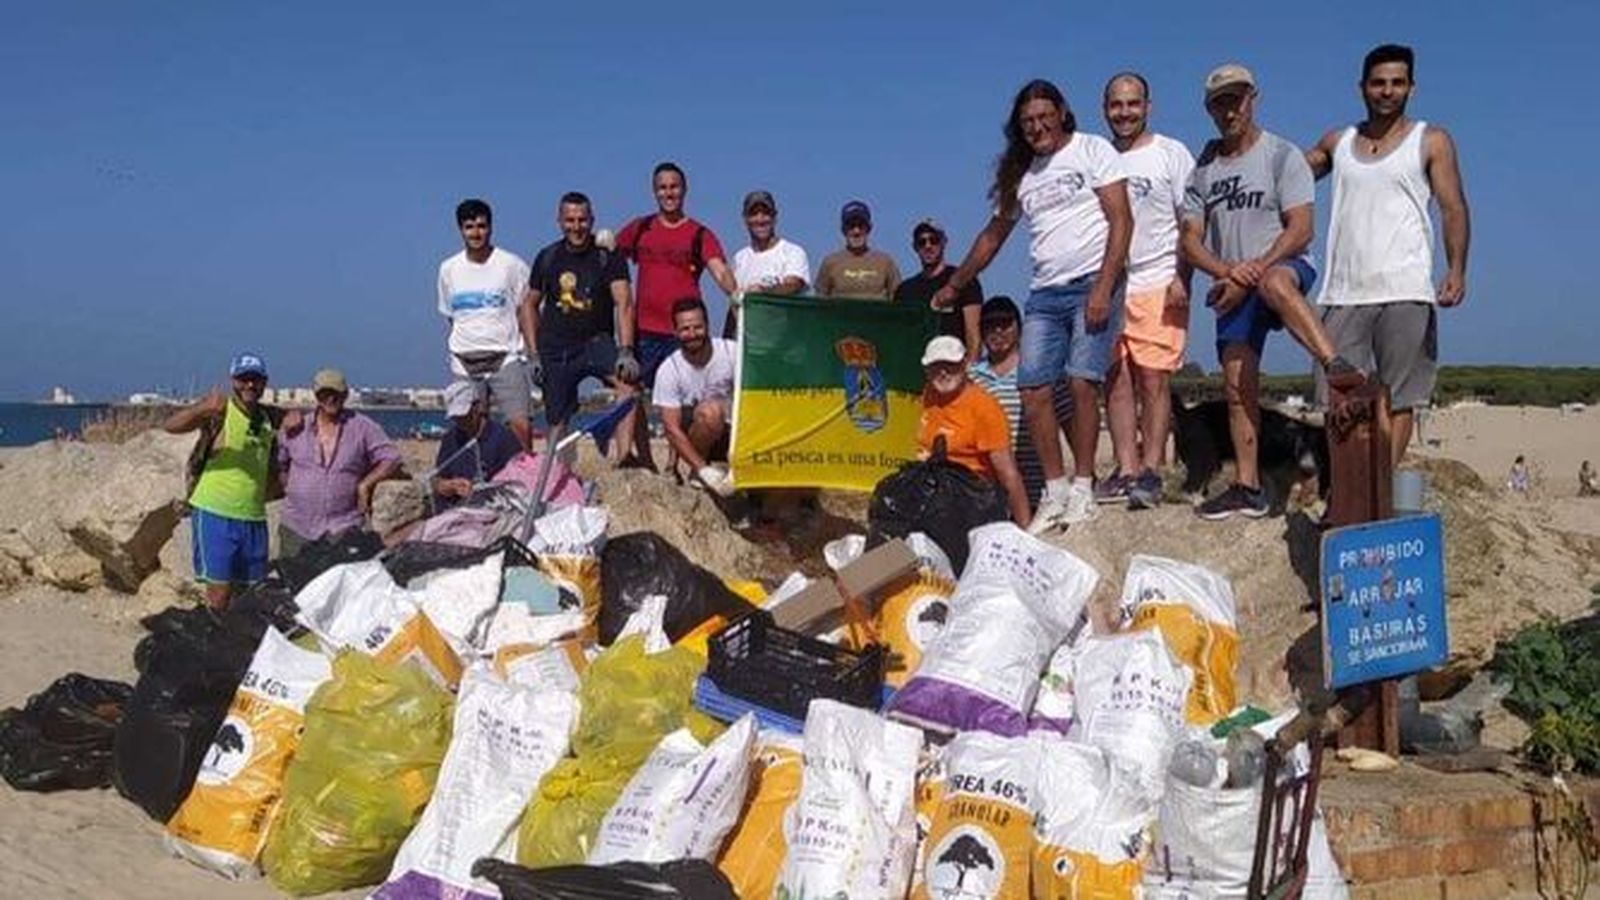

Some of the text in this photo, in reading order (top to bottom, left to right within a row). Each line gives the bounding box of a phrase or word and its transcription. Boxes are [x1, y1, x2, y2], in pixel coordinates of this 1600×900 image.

[778, 452, 823, 469] pesca
[828, 453, 844, 464] es
[849, 453, 876, 466] una
[1340, 539, 1424, 569] PRIBIDO
[1350, 577, 1424, 606] ARRJAR
[951, 774, 1028, 804] REA 46%
